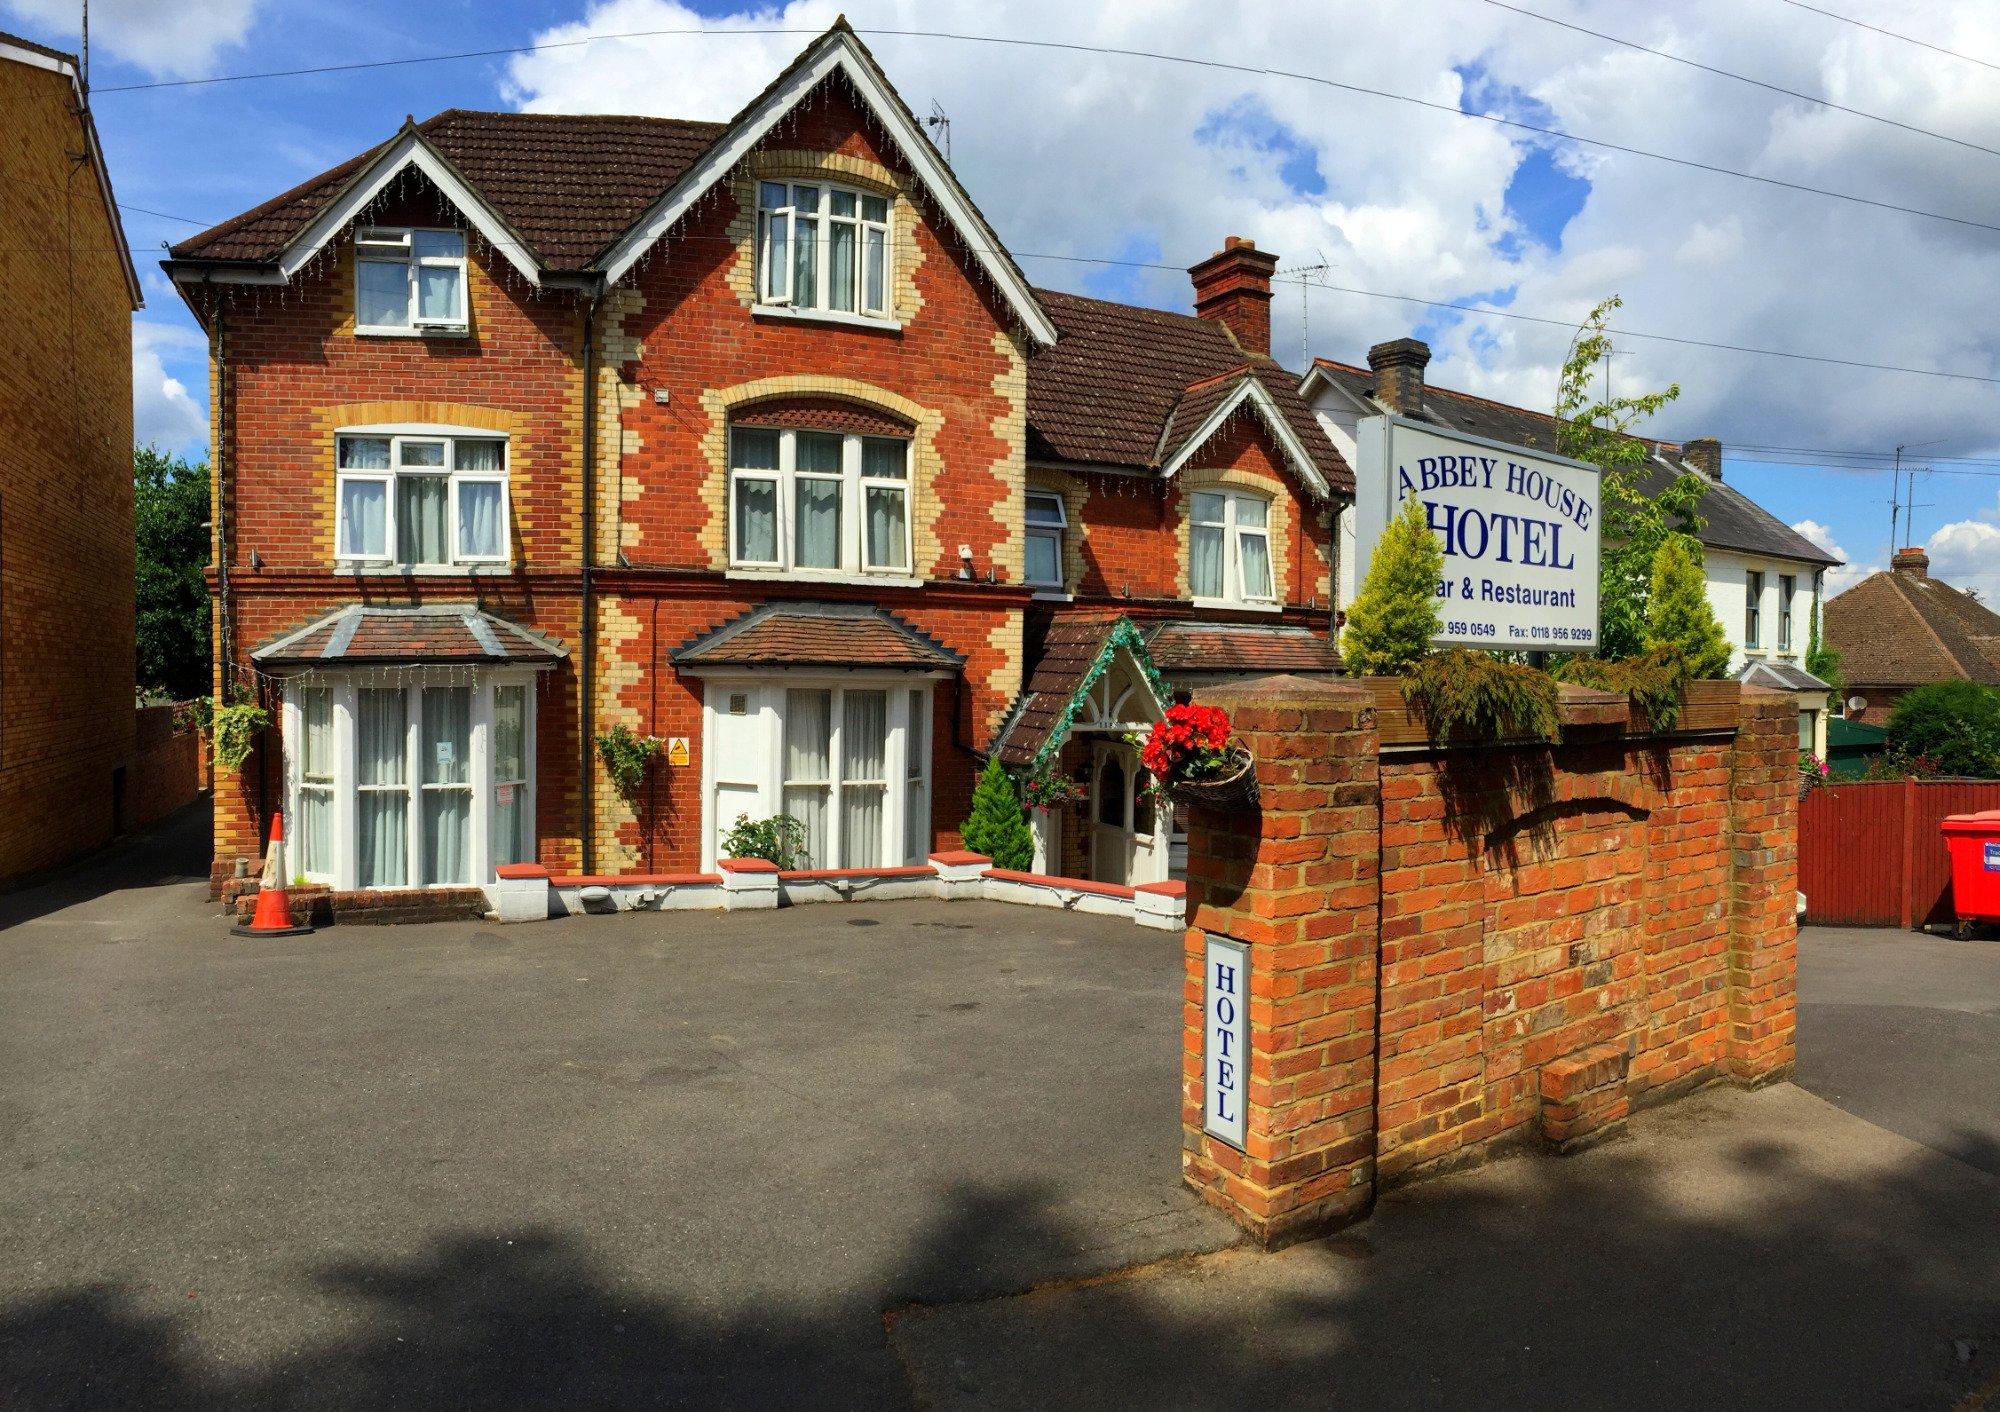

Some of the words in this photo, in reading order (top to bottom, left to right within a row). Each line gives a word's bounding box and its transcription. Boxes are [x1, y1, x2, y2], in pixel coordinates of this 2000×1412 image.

[1398, 456, 1497, 501] ABBEY
[1506, 462, 1592, 531] HOUSE
[1422, 501, 1574, 570] HOTEL
[1436, 579, 1454, 598] ar
[1462, 577, 1474, 599] &
[1482, 579, 1575, 608] Restaurant
[1448, 622, 1467, 635] 959
[1470, 622, 1495, 637] 0549
[1509, 626, 1529, 638] Fax:
[1531, 627, 1550, 639] 0118
[1552, 628, 1568, 640] 956
[1571, 628, 1592, 640] 9299
[1216, 963, 1235, 1122] HOTEL
